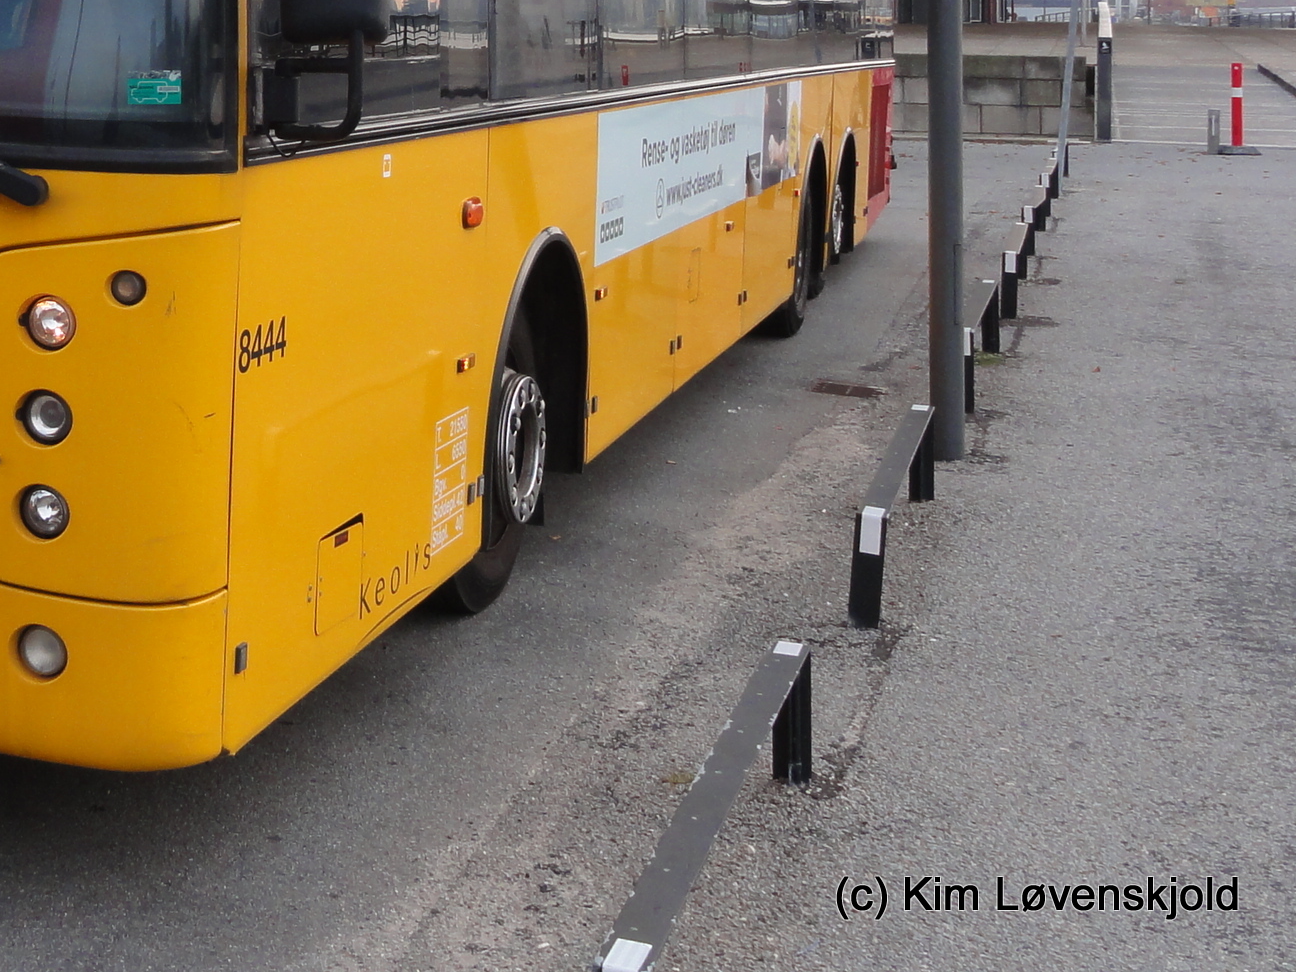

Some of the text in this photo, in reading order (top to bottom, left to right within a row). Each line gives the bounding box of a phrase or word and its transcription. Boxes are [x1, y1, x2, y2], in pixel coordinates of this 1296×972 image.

[641, 119, 736, 168] Rense- og vasketøj til døren
[238, 315, 287, 374] 8444
[358, 542, 432, 620] Keolis
